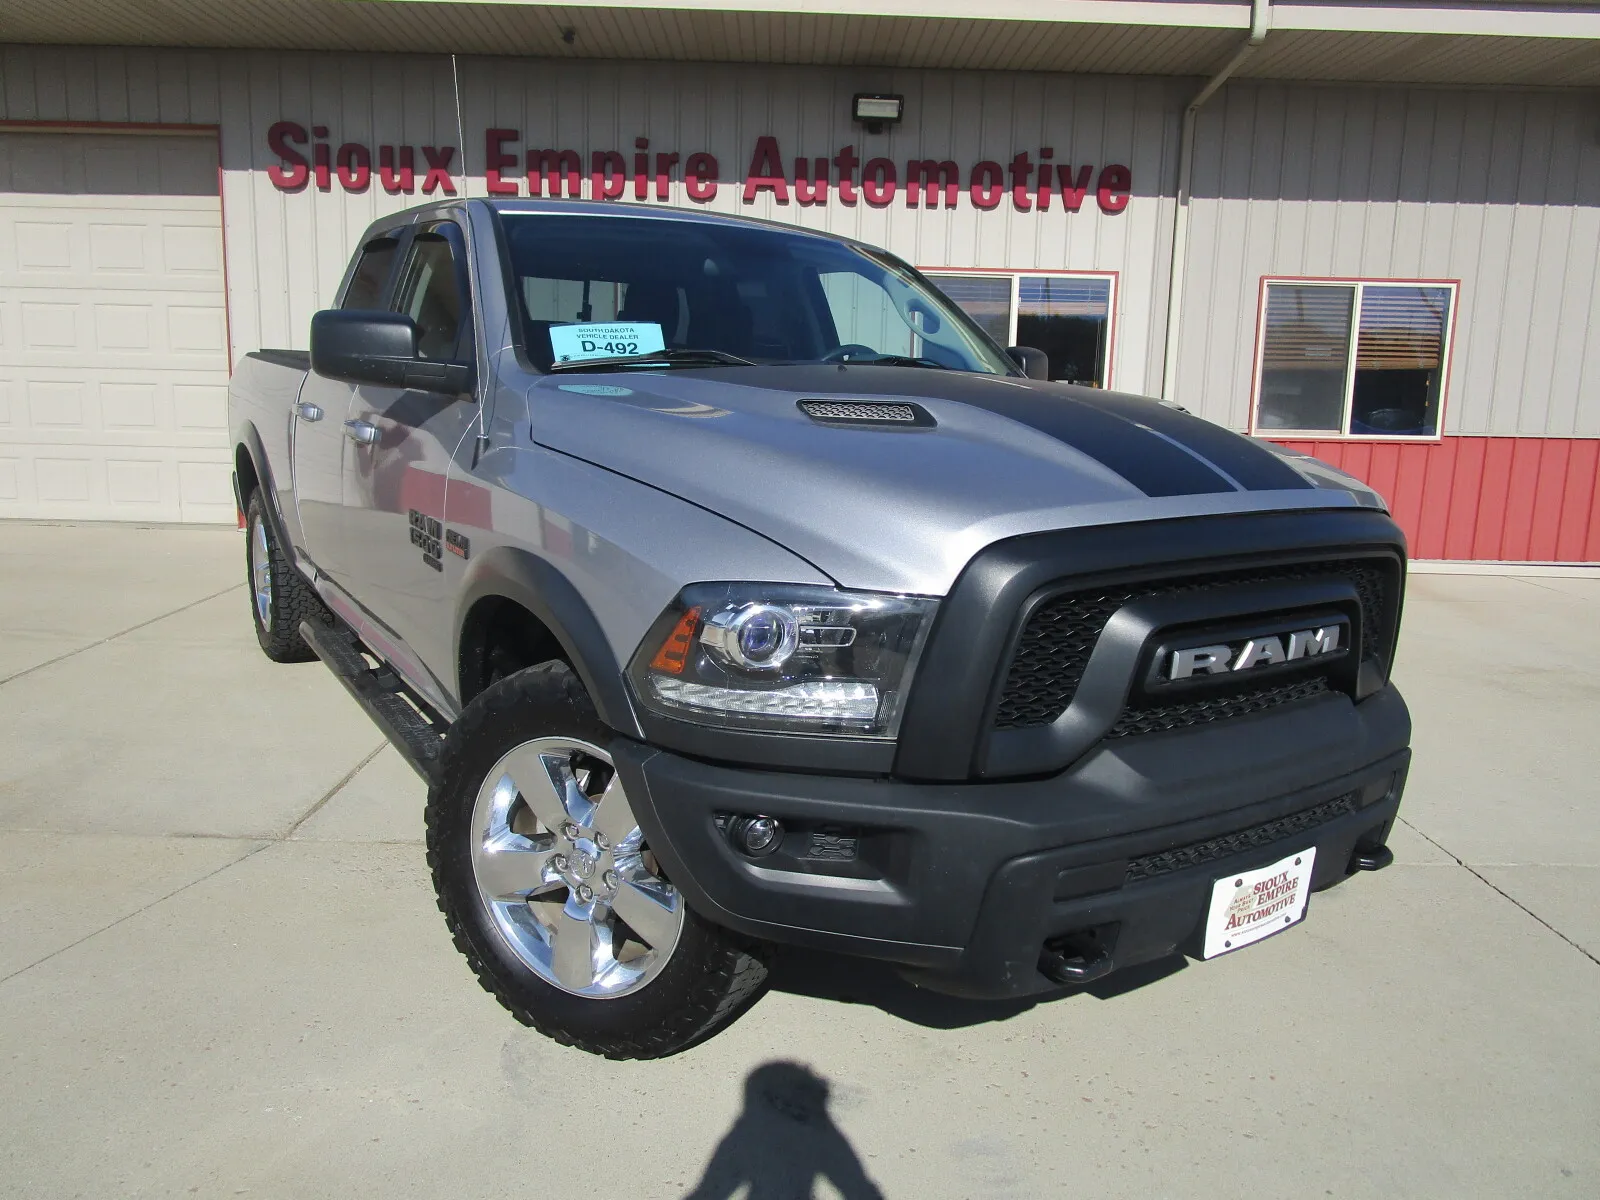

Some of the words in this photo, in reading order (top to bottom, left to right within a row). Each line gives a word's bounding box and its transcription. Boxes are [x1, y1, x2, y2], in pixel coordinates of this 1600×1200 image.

[267, 121, 457, 195] Sioux
[485, 128, 718, 203] Empire
[742, 136, 1132, 216] Automotive
[581, 340, 639, 355] D-492
[1170, 625, 1340, 680] RAM
[1253, 870, 1289, 895] SIOUX
[1256, 877, 1299, 907] EMPIRE
[1224, 893, 1296, 931] AUTOMOTIVE
